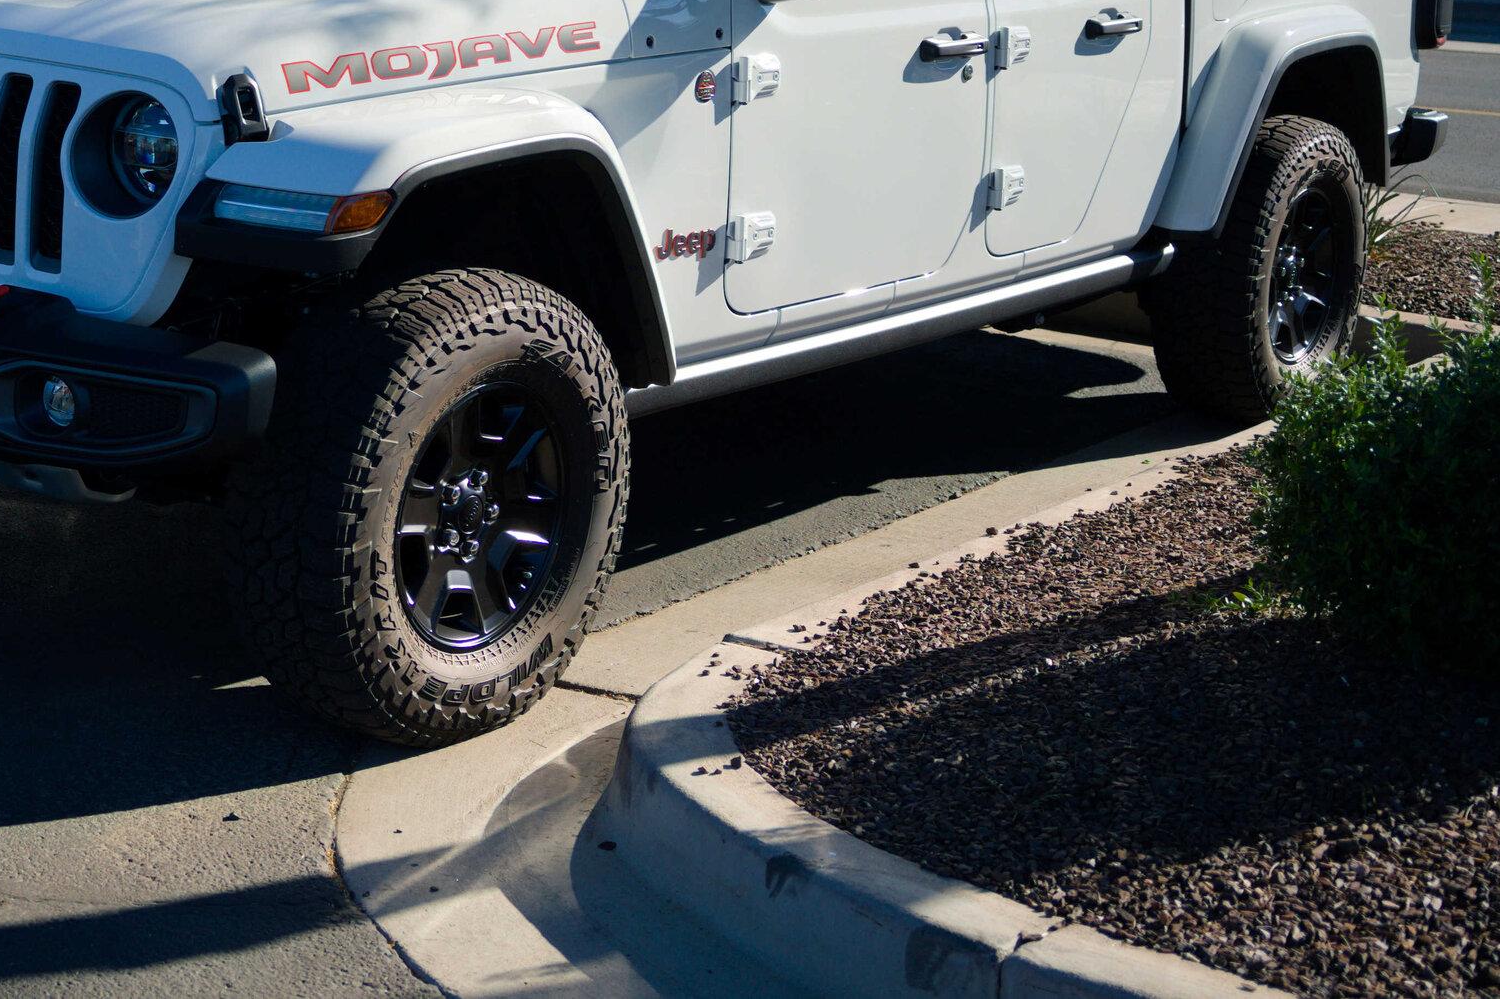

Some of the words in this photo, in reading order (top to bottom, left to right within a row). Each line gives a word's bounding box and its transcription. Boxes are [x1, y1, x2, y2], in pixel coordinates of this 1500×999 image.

[280, 21, 601, 95] MOJAVE
[653, 227, 717, 262] Jeep
[383, 632, 554, 706] WILDPEAK
